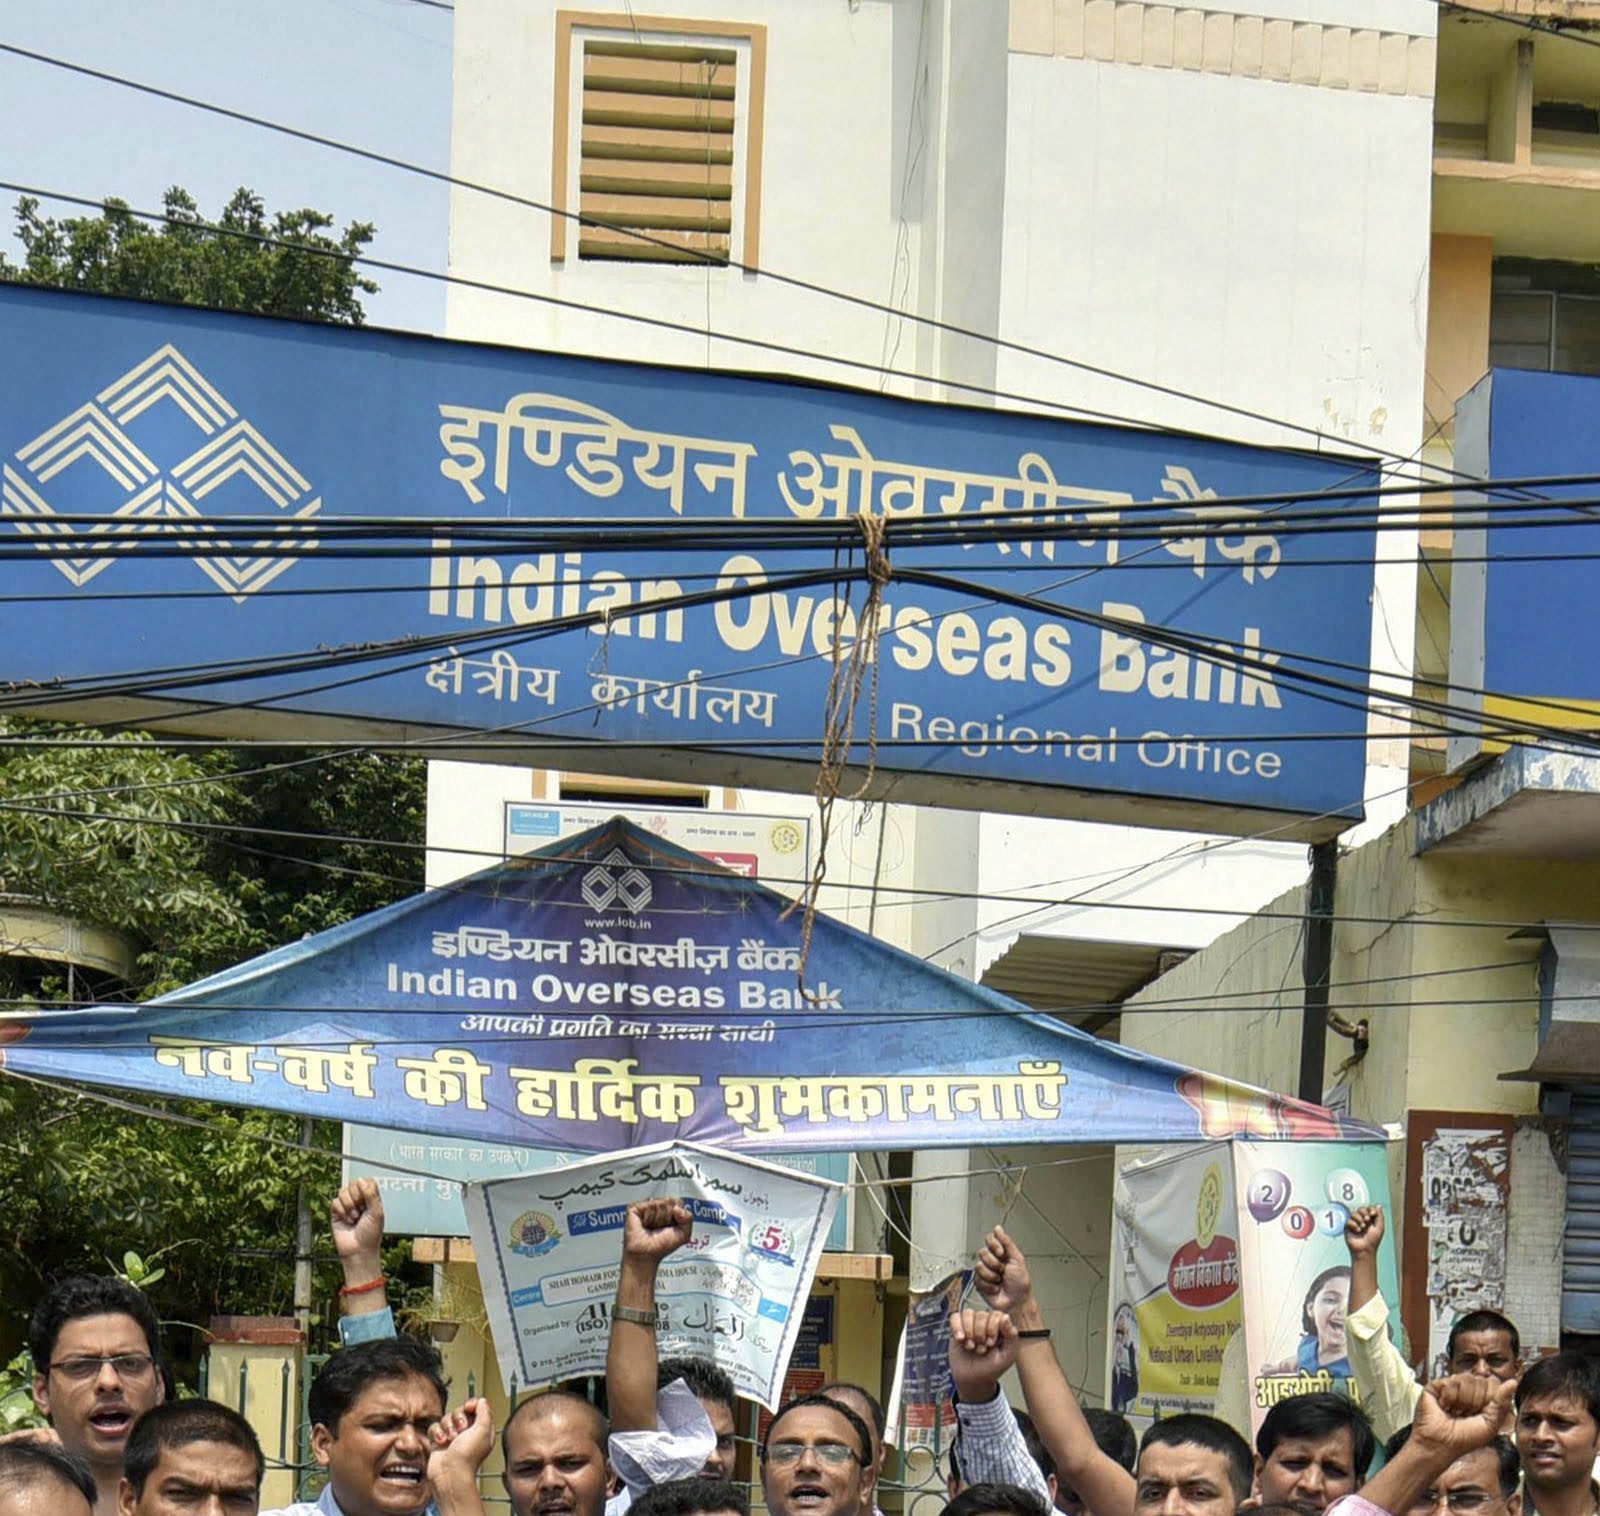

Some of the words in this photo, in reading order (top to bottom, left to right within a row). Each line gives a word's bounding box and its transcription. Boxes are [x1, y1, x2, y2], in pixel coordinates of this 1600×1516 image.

[439, 392, 757, 518] इण्डियन
[429, 527, 683, 643] Indian
[714, 555, 1072, 687] Overseas
[1100, 602, 1283, 710] Bank
[425, 645, 561, 705] क्षेत्रीय
[591, 668, 778, 729] कार्यालय
[892, 703, 1117, 768] Regional
[1137, 720, 1283, 780] Office
[432, 925, 573, 966] इण्डियन
[737, 939, 802, 972] बैंक
[387, 963, 518, 1001] Indian
[532, 974, 730, 1009] Overseas
[739, 981, 843, 1011] Bank
[397, 1048, 491, 1111] की
[510, 1058, 700, 1124] हार्दिक
[694, 1201, 727, 1223] Camp
[762, 1227, 782, 1250] 5
